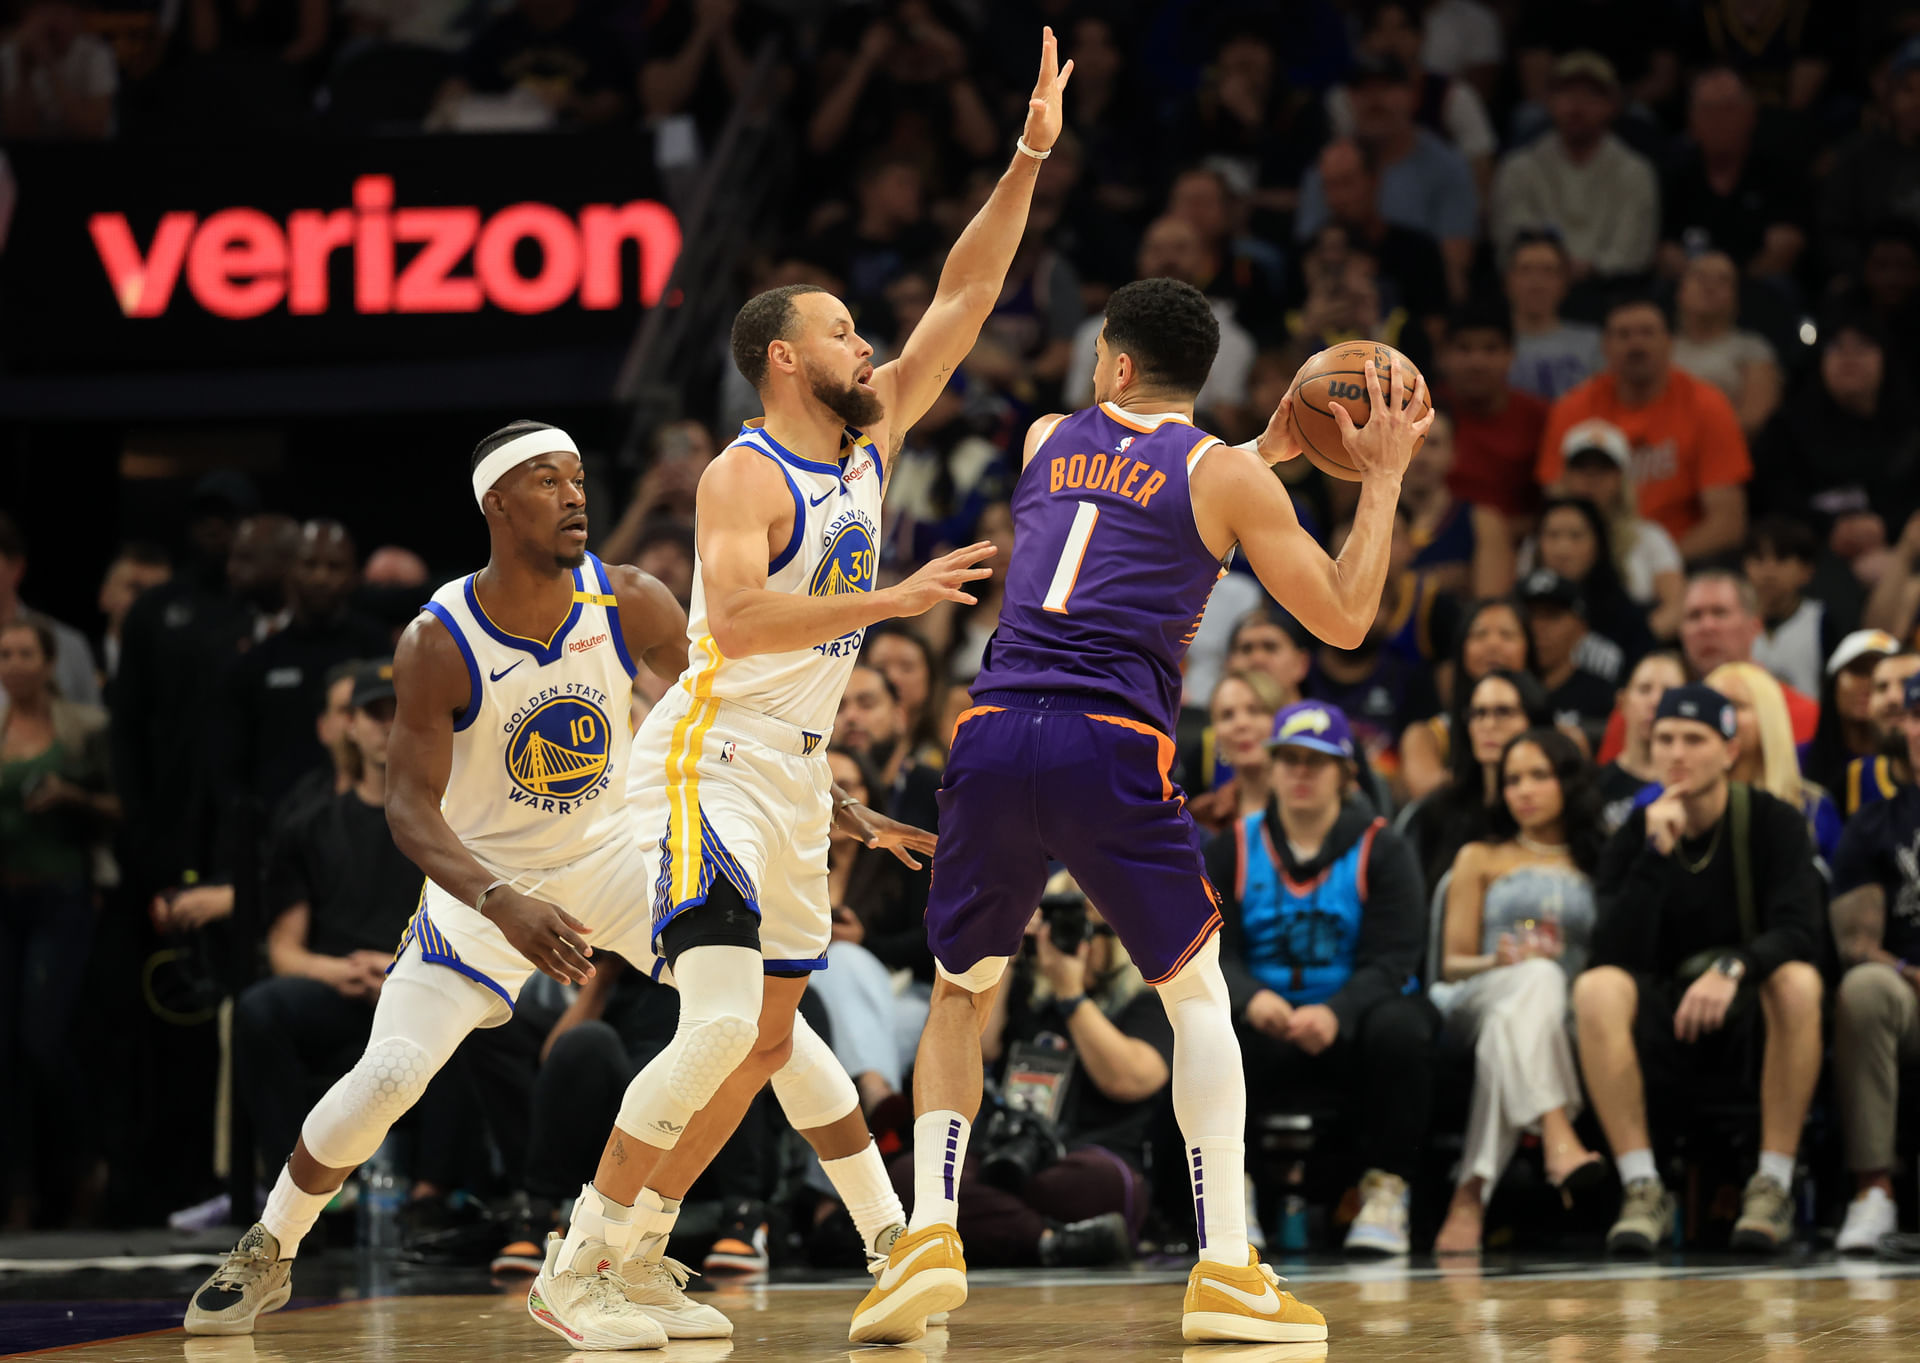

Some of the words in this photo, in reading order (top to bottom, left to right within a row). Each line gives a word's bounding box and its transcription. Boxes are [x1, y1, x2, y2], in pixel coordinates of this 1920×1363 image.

[88, 174, 682, 318] verizon
[1050, 453, 1166, 508] BOOKER
[823, 509, 856, 547] OLDEN
[857, 509, 877, 538] STATE
[848, 549, 872, 583] 30
[1041, 500, 1100, 615] 1
[568, 632, 608, 653] Rakuten
[503, 685, 558, 734] GOLDEN
[566, 682, 608, 705] STATE
[569, 715, 596, 747] 10
[508, 763, 614, 815] WARRIORS
